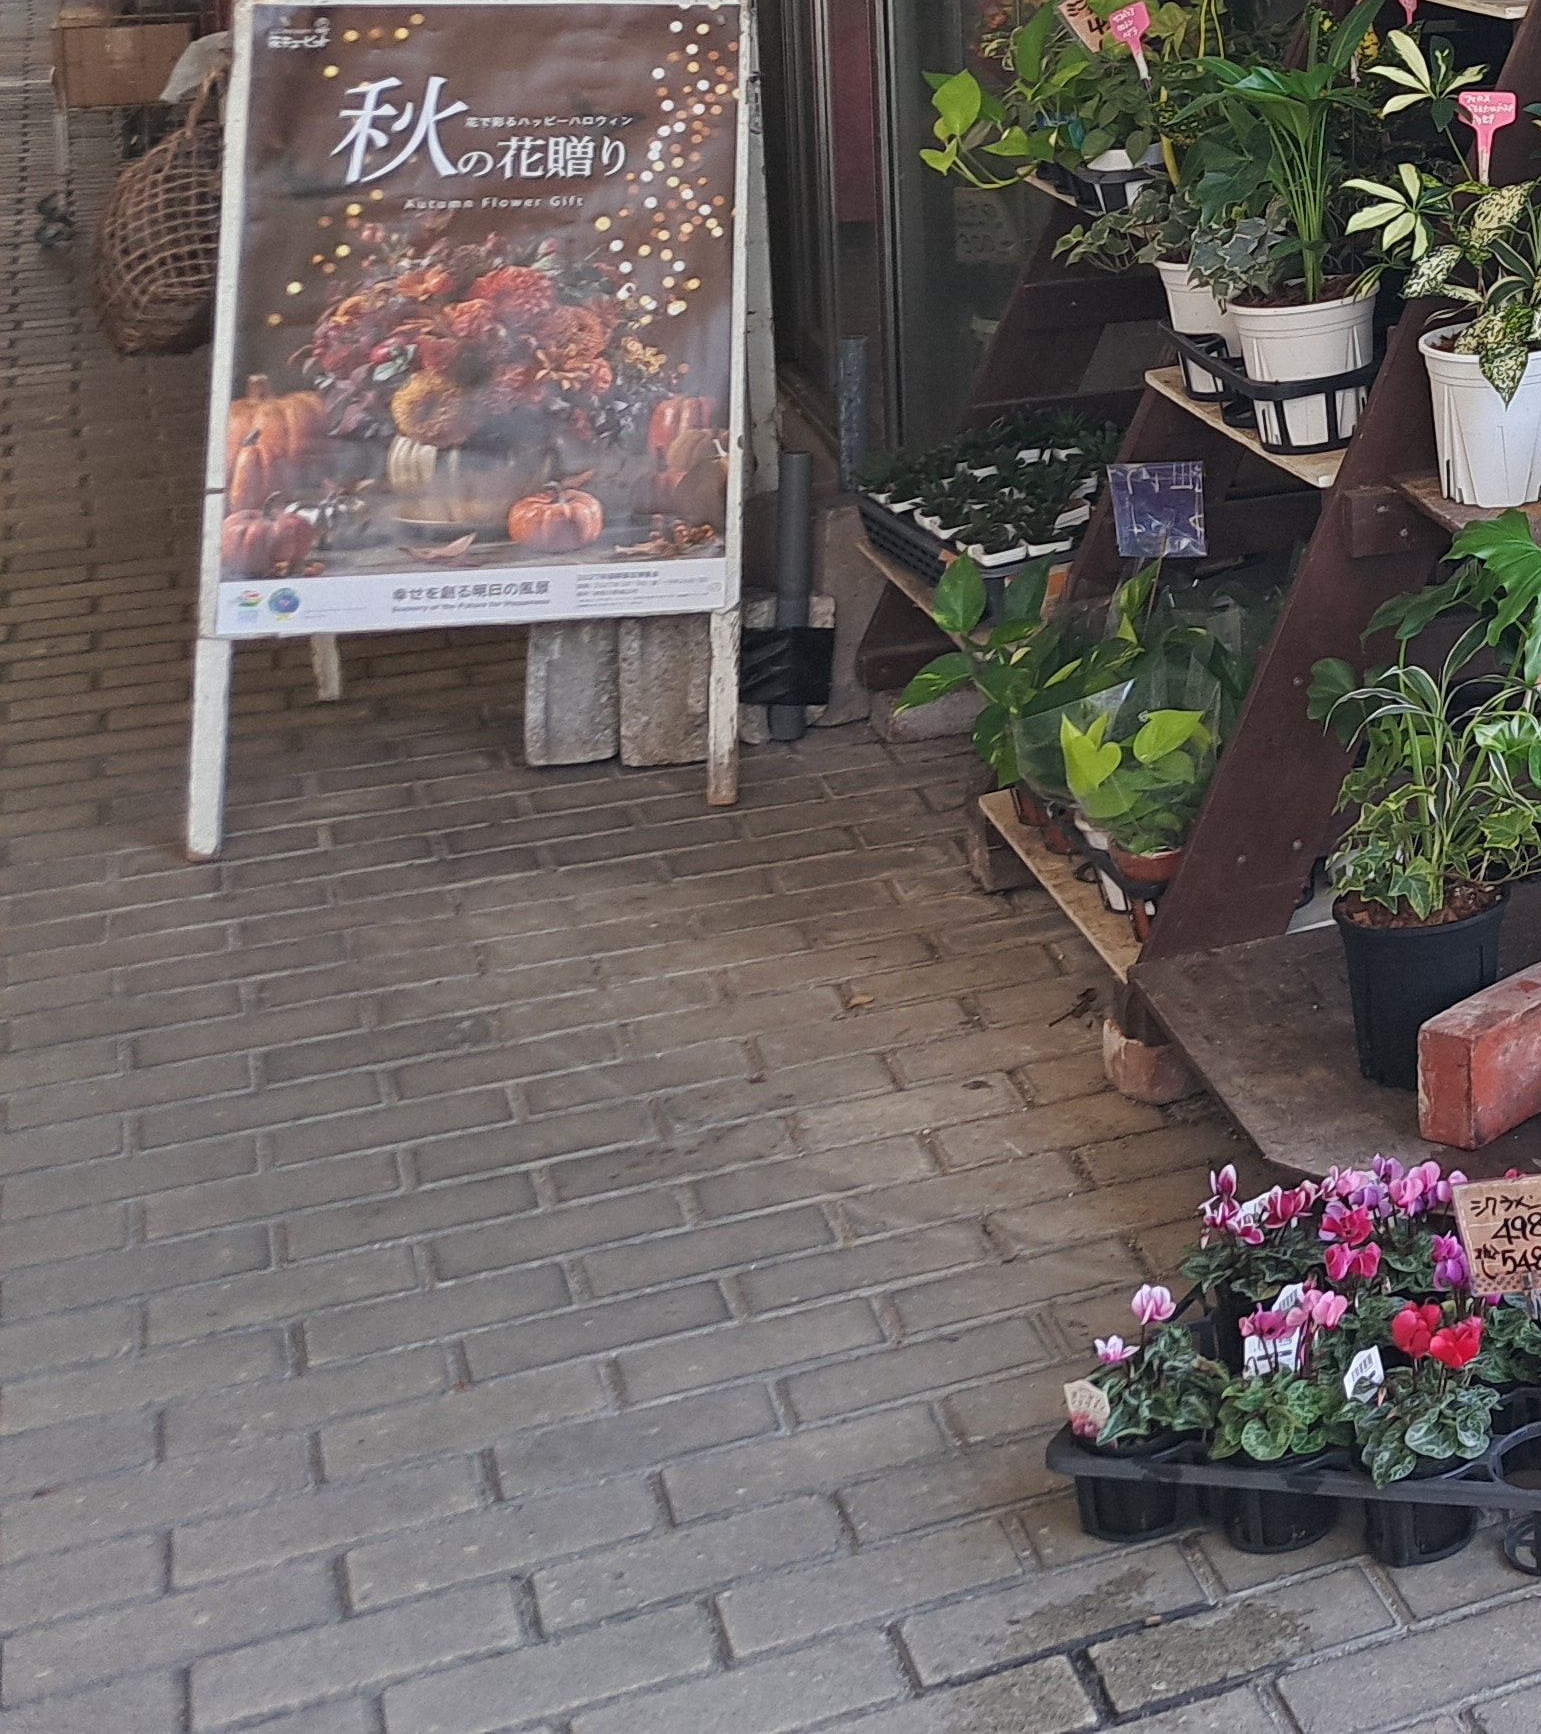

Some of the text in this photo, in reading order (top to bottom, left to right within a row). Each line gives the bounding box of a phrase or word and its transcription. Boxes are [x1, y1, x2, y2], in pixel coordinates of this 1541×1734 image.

[328, 75, 628, 185] 秋の花贈り
[404, 195, 584, 210] Autumn Flower Gift
